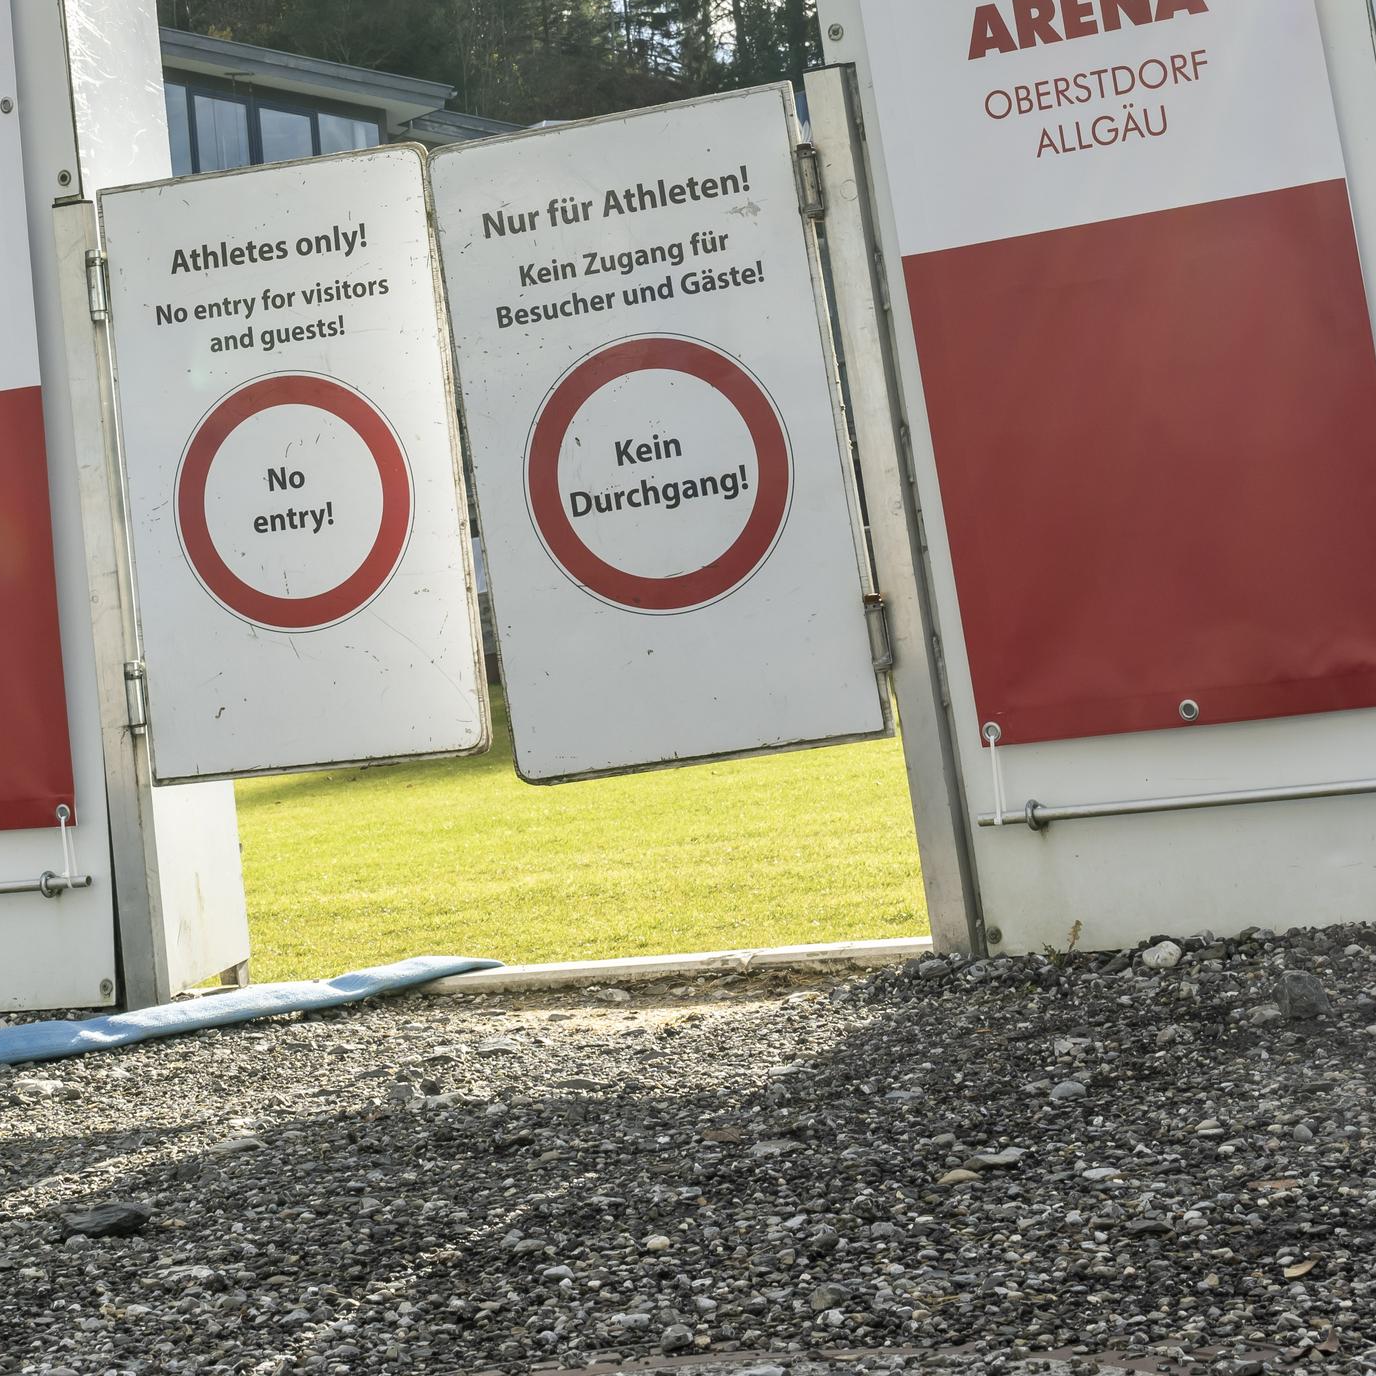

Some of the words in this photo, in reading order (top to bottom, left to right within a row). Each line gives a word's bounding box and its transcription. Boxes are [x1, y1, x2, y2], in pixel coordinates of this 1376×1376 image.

[985, 49, 1208, 120] OBERSTDORF
[1036, 103, 1168, 158] ALLGÄU
[482, 209, 540, 239] Nur
[547, 197, 593, 227] für
[602, 165, 750, 218] Athleten!
[170, 239, 288, 275] Athletes
[295, 223, 368, 257] only!
[519, 258, 577, 287] Kein
[583, 239, 684, 275] Zugang
[690, 230, 729, 257] für
[155, 304, 188, 326] No
[194, 293, 256, 321] entry
[261, 288, 295, 312] for
[301, 276, 390, 305] visitors
[495, 290, 615, 329] Besucher
[623, 276, 674, 307] und
[680, 260, 765, 295] Gäste!
[210, 327, 254, 353] and
[261, 314, 345, 352] guests!
[614, 434, 682, 467] Kein
[267, 466, 305, 492] No
[569, 464, 749, 518] Durchgang!
[253, 501, 334, 534] entry!
